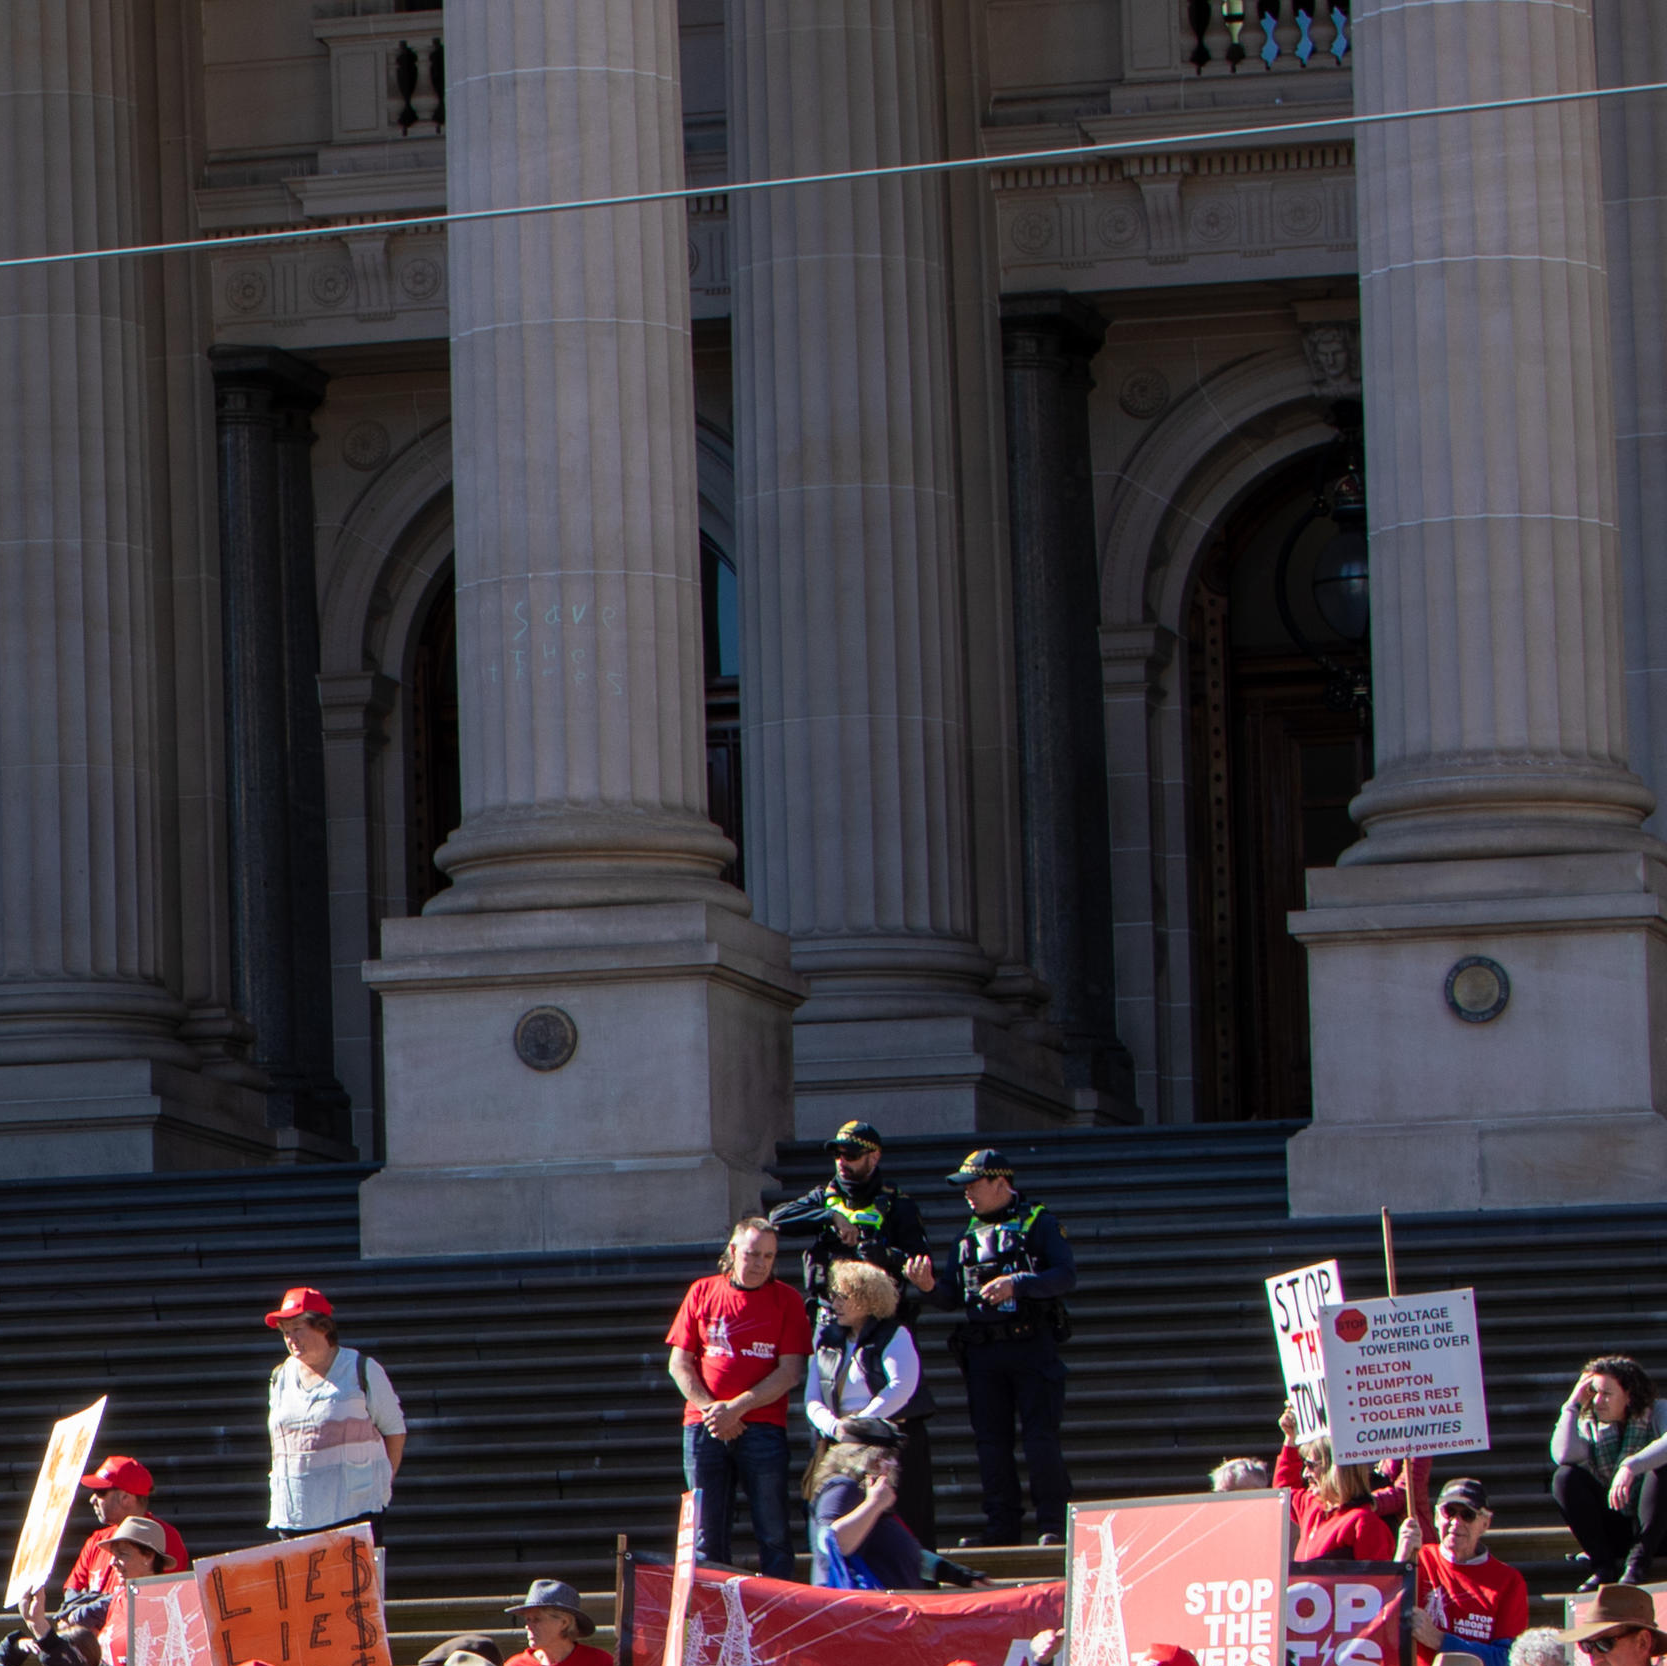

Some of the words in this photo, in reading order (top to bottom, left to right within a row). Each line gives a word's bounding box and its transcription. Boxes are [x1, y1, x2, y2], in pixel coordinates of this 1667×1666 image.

[1274, 1270, 1331, 1332] STOP
[1374, 1313, 1387, 1325] HI
[1389, 1307, 1449, 1324] VOLTAGE
[1372, 1326, 1420, 1340] POWER
[1425, 1322, 1454, 1335] LINE
[1358, 1339, 1430, 1357] TOWERING
[1433, 1335, 1470, 1348] OVER
[1356, 1360, 1411, 1376] MELTON
[1357, 1374, 1434, 1391] PLUMPTON
[1359, 1391, 1420, 1407] DIGGERS
[1425, 1387, 1459, 1399] REST
[1361, 1406, 1425, 1423] TOOLERN
[1428, 1402, 1463, 1414] VALE
[1357, 1420, 1461, 1443] COMMUNITIES
[1345, 1438, 1474, 1459] no-overhead-power.com
[1184, 1579, 1273, 1615] STOP
[1204, 1612, 1271, 1647] THE
